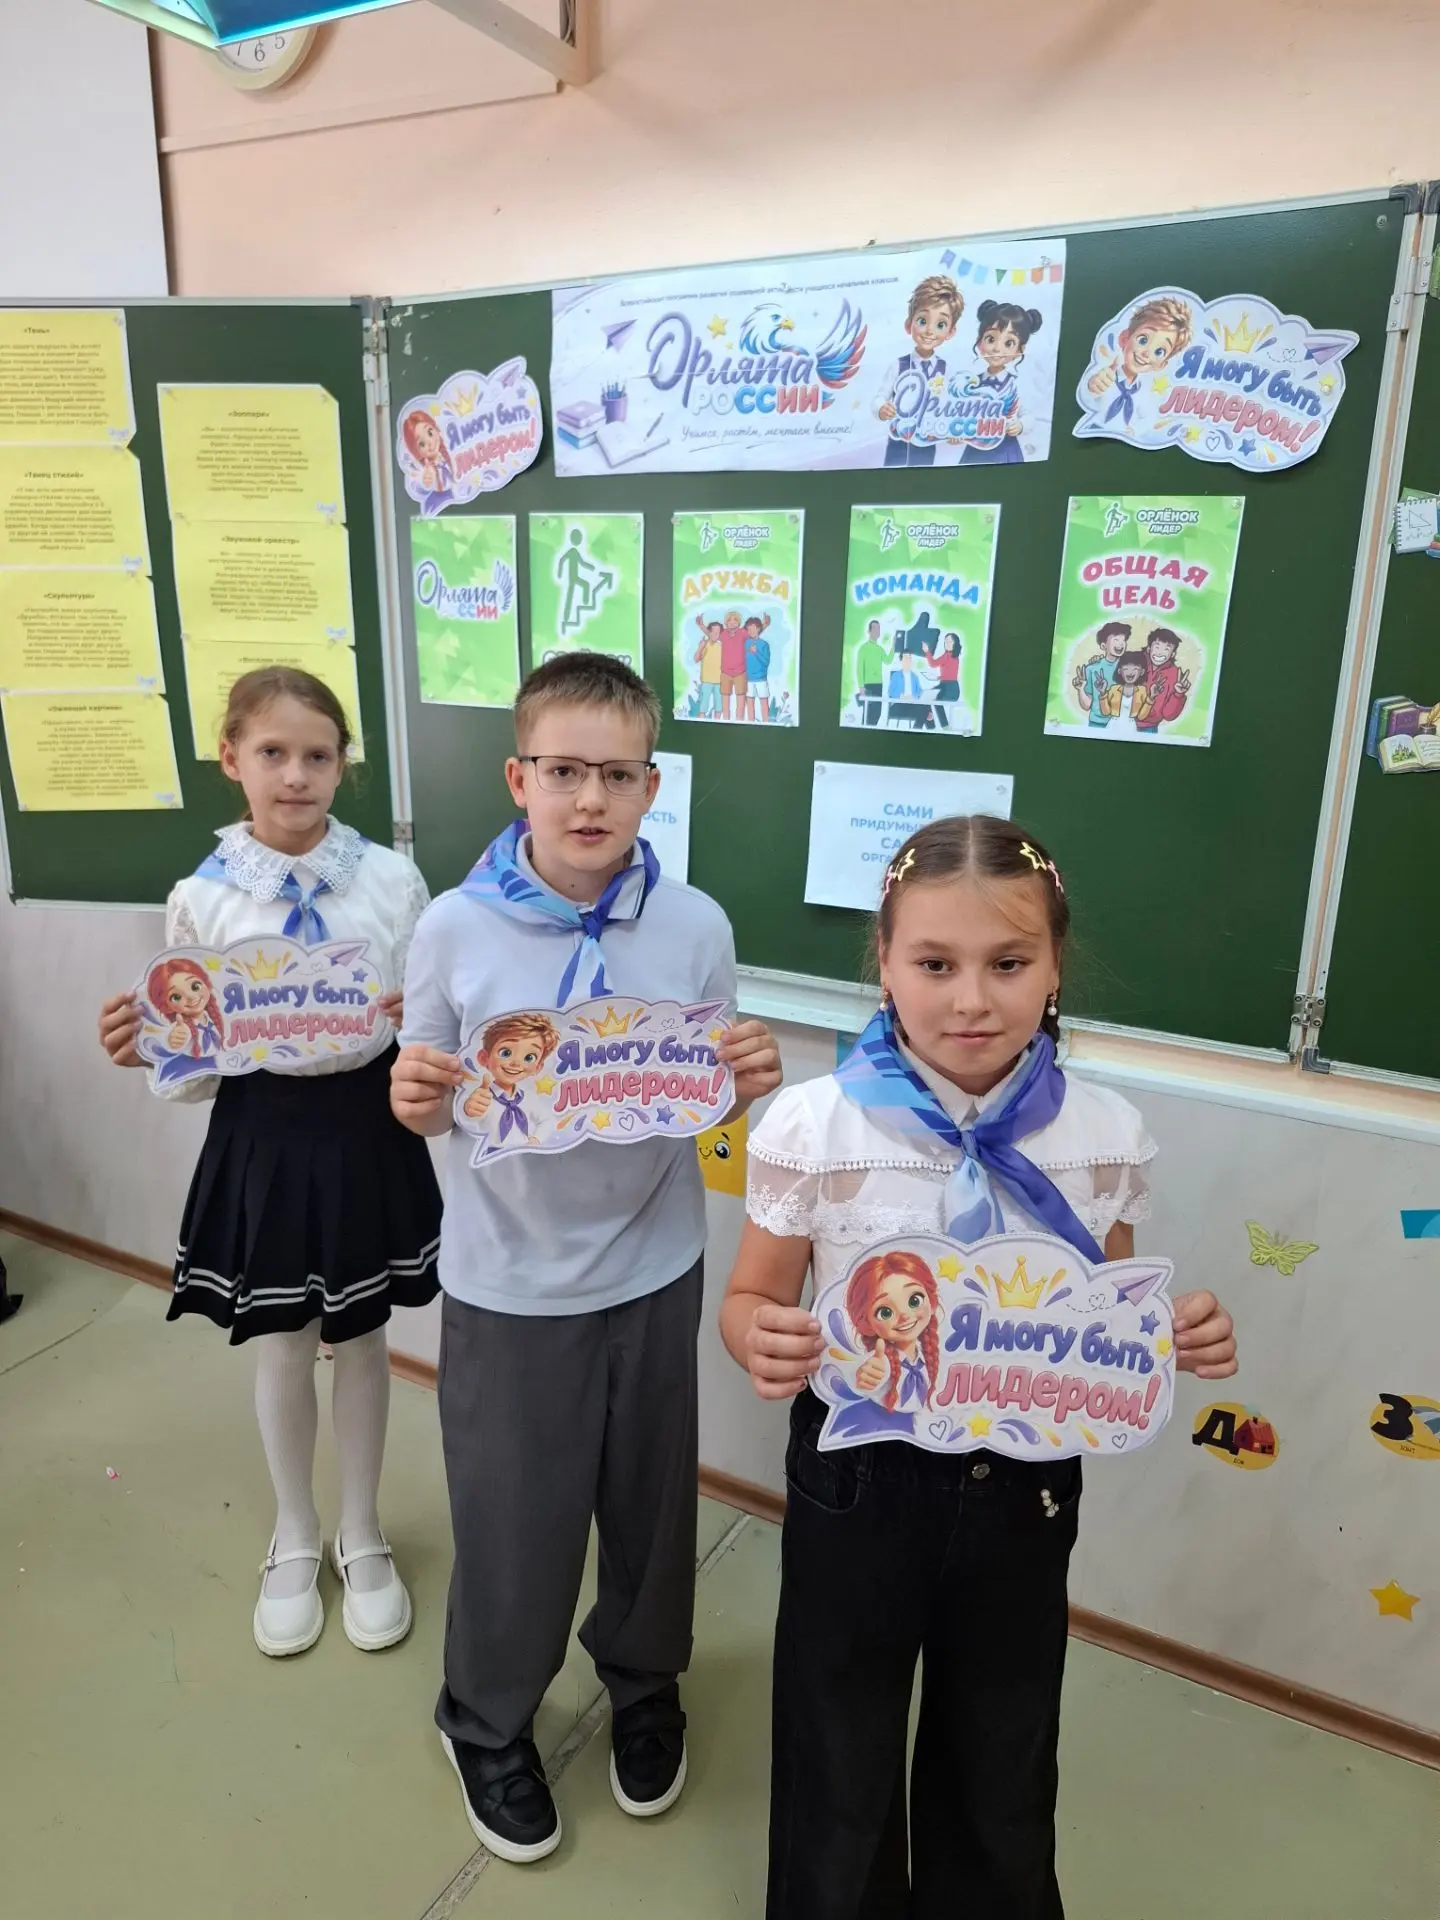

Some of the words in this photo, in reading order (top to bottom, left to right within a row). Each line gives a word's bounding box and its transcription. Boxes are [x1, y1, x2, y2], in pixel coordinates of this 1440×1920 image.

[254, 43, 266, 62] 6
[647, 311, 815, 408] Орлята
[1175, 345, 1207, 379] Я
[1201, 357, 1270, 392] могу
[1267, 369, 1322, 416] быть
[691, 384, 820, 415] РОССИИ
[894, 371, 1000, 428] Орлята
[447, 422, 460, 451] Я
[460, 411, 495, 442] могу
[497, 402, 531, 426] быть
[1159, 386, 1321, 453] лидером!
[724, 525, 770, 539] ОРЛЁНОК
[907, 523, 960, 537] ОРЛЁНОК
[1137, 508, 1200, 523] ОРЛЁНОК
[1149, 524, 1182, 535] ЛИДЕР
[734, 539, 759, 549] ЛИДЕР
[918, 538, 945, 548] ЛИДЕР
[417, 560, 498, 610] Орлята
[684, 569, 790, 603] ДРУЖБА
[855, 573, 980, 604] КОМАНДА
[1083, 555, 1209, 588] ОБЩАЯ
[1103, 585, 1175, 609] ЦЕЛЬ
[883, 803, 934, 819] САМИ
[224, 982, 245, 1014] Я
[249, 984, 309, 1009] могу
[312, 979, 369, 1005] быть
[226, 1005, 378, 1048] лидером!
[556, 1039, 580, 1075] Я
[585, 1040, 655, 1066] могу
[658, 1035, 719, 1066] быть
[553, 1067, 727, 1112] лидером!
[944, 1303, 982, 1352] Я
[983, 1319, 1077, 1364] могу
[1080, 1321, 1155, 1375] быть
[936, 1362, 1162, 1430] лидером!
[1192, 1408, 1240, 1456] Д
